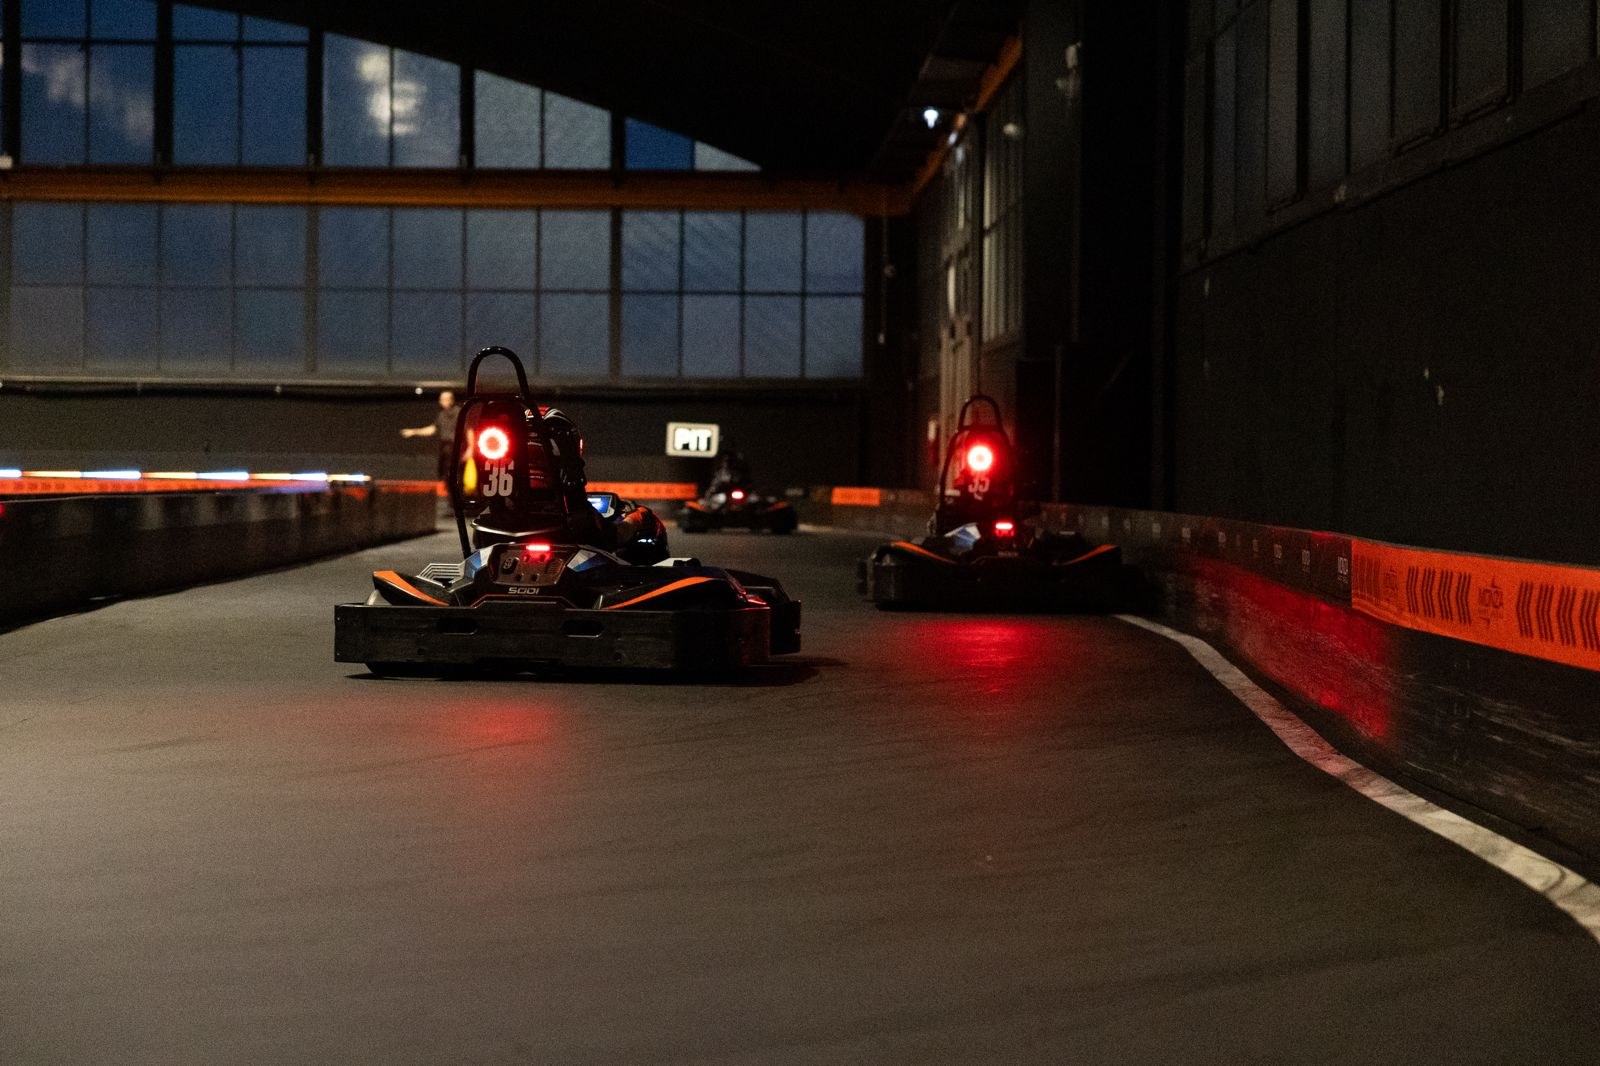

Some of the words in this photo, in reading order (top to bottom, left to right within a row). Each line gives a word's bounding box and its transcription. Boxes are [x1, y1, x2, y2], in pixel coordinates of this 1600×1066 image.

[674, 428, 712, 452] PIT
[483, 460, 515, 497] 36
[508, 587, 540, 595] SODI
